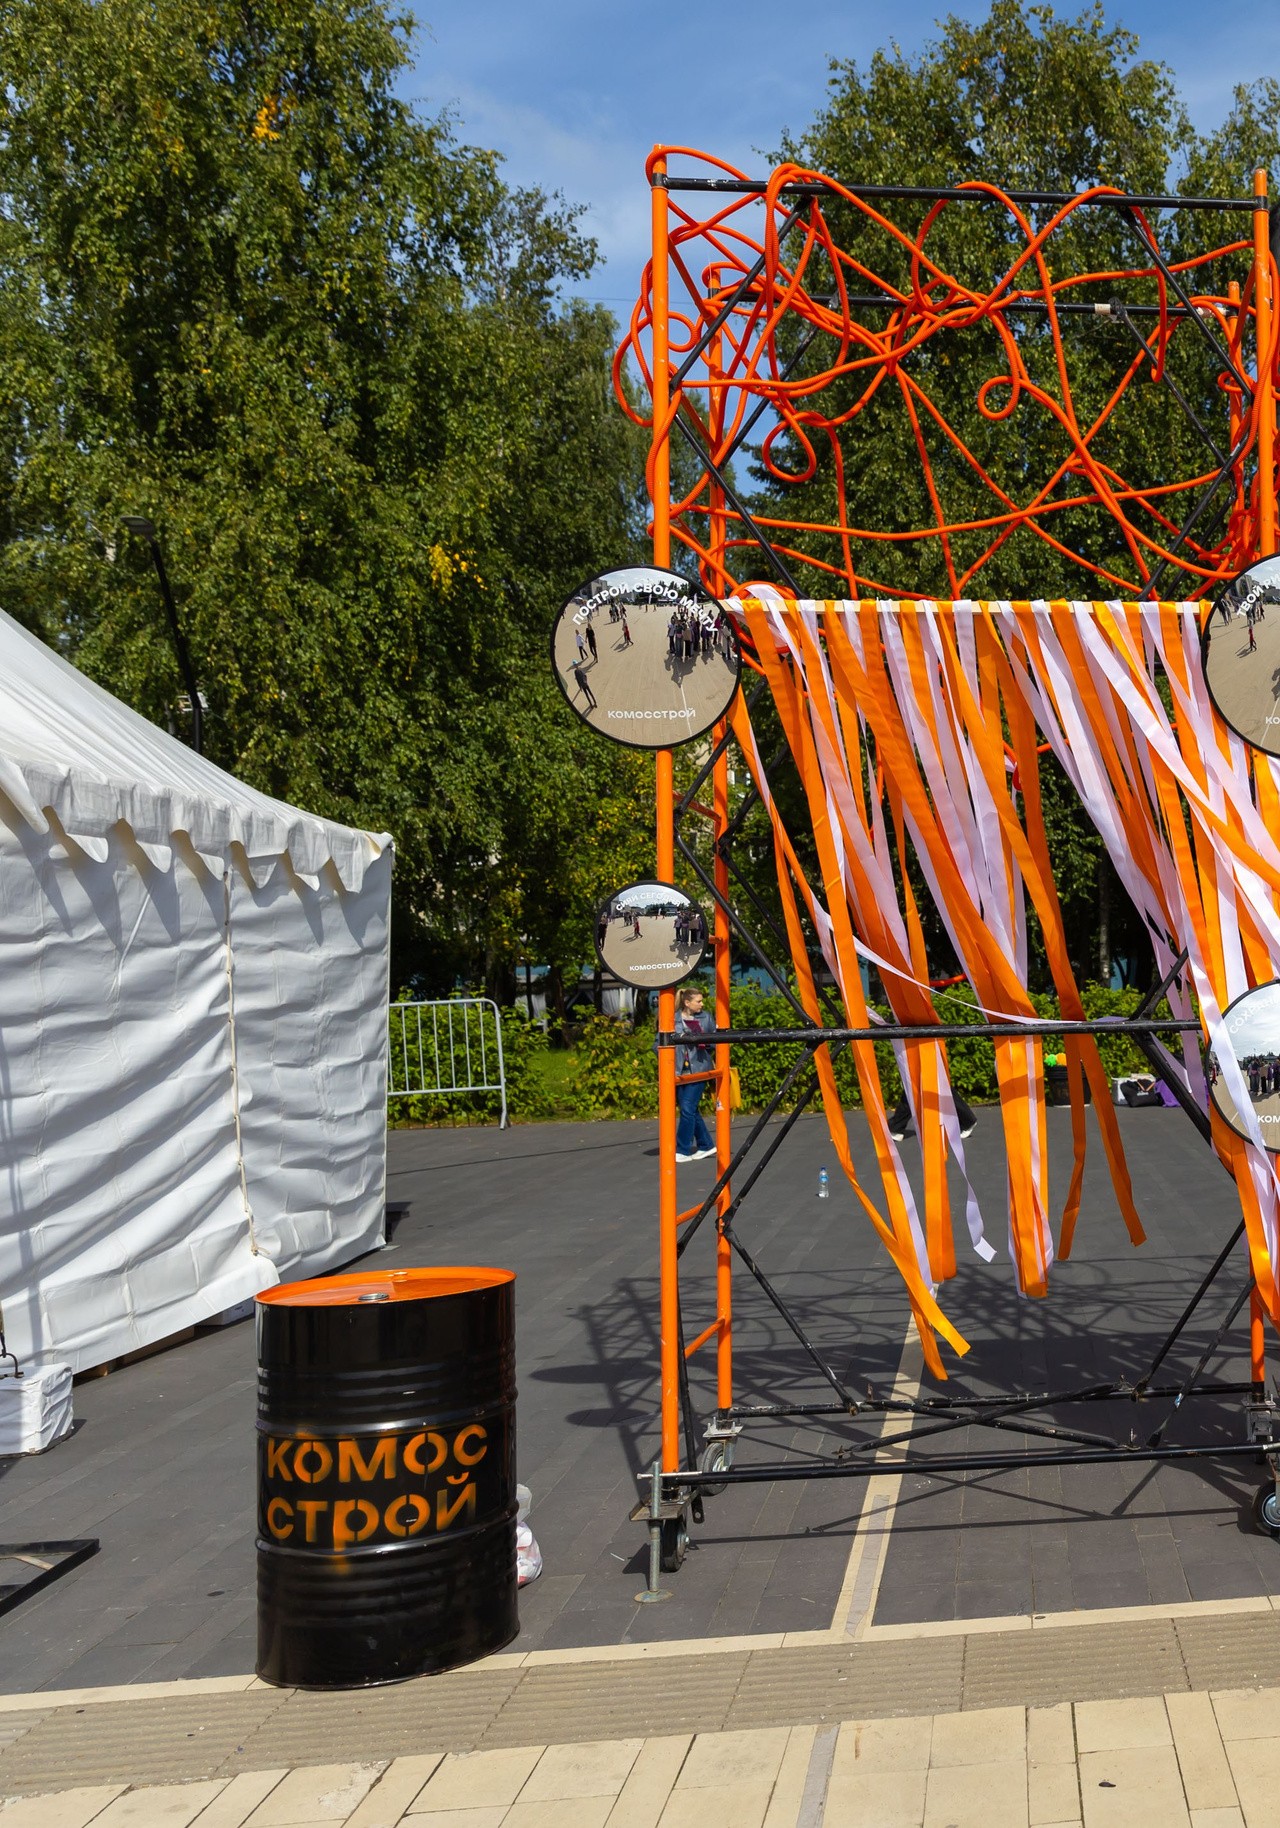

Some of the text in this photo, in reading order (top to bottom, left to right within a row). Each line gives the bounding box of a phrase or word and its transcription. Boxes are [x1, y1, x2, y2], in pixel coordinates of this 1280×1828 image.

[572, 582, 719, 632] ПОСТРОЙ СВОЮ МЕЧТУ
[1236, 584, 1264, 617] ТВОЙ
